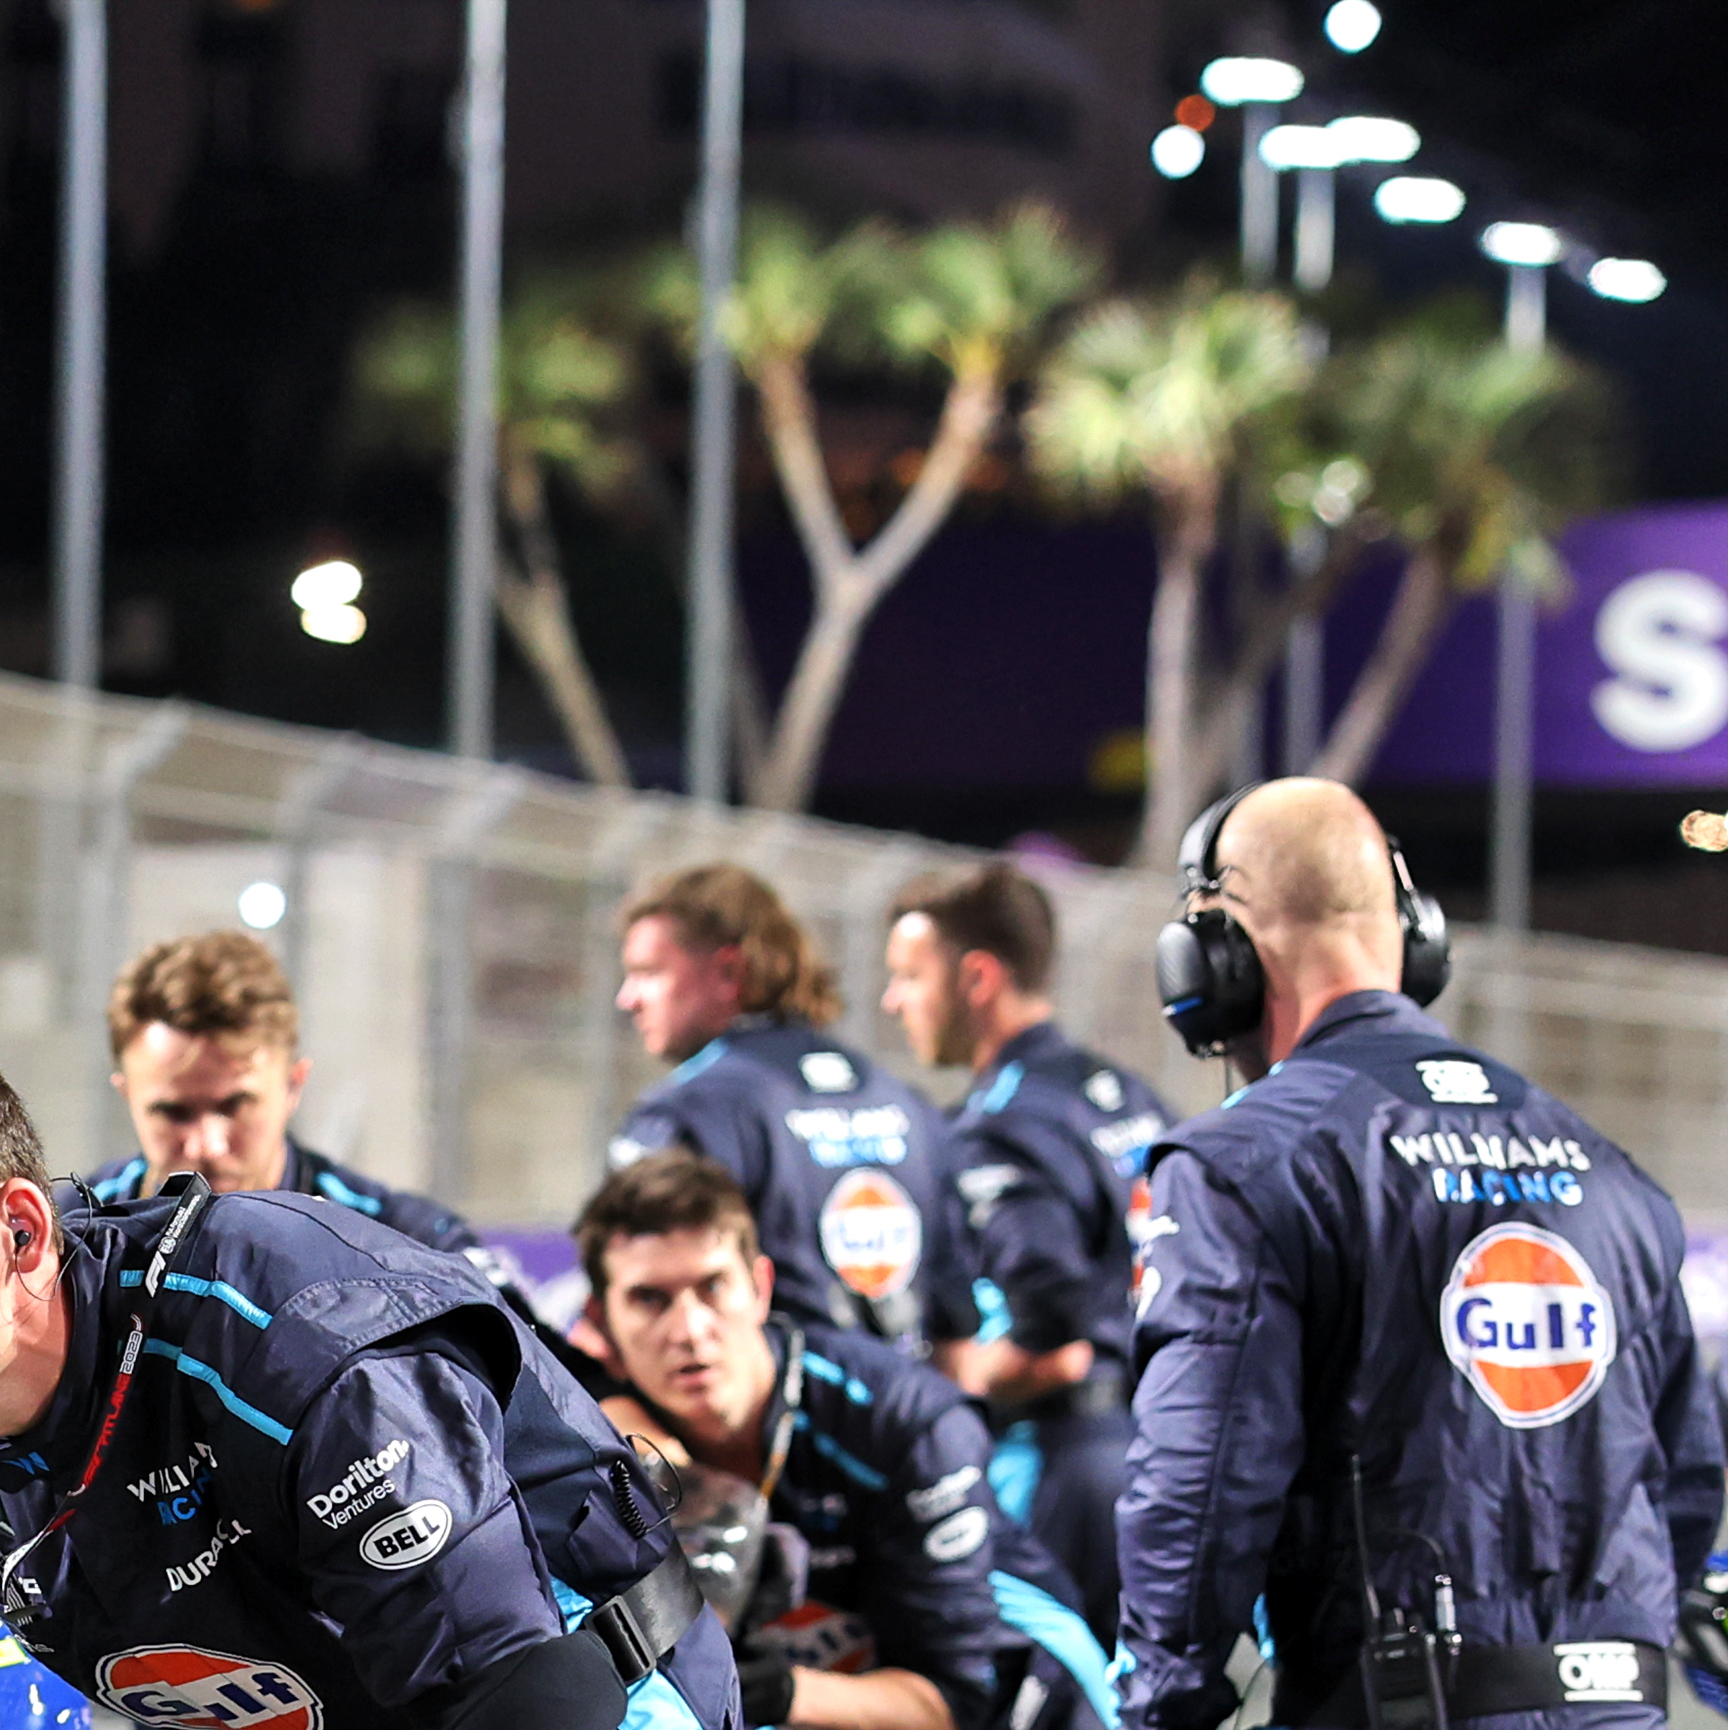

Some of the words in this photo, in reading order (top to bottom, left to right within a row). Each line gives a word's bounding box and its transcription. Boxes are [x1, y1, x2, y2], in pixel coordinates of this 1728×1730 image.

[1390, 1132, 1591, 1171] WILLIAMS
[1457, 1298, 1597, 1350] Gulf
[120, 1330, 144, 1375] 2023
[322, 1478, 396, 1530] Ventures
[373, 1516, 441, 1559] BELL
